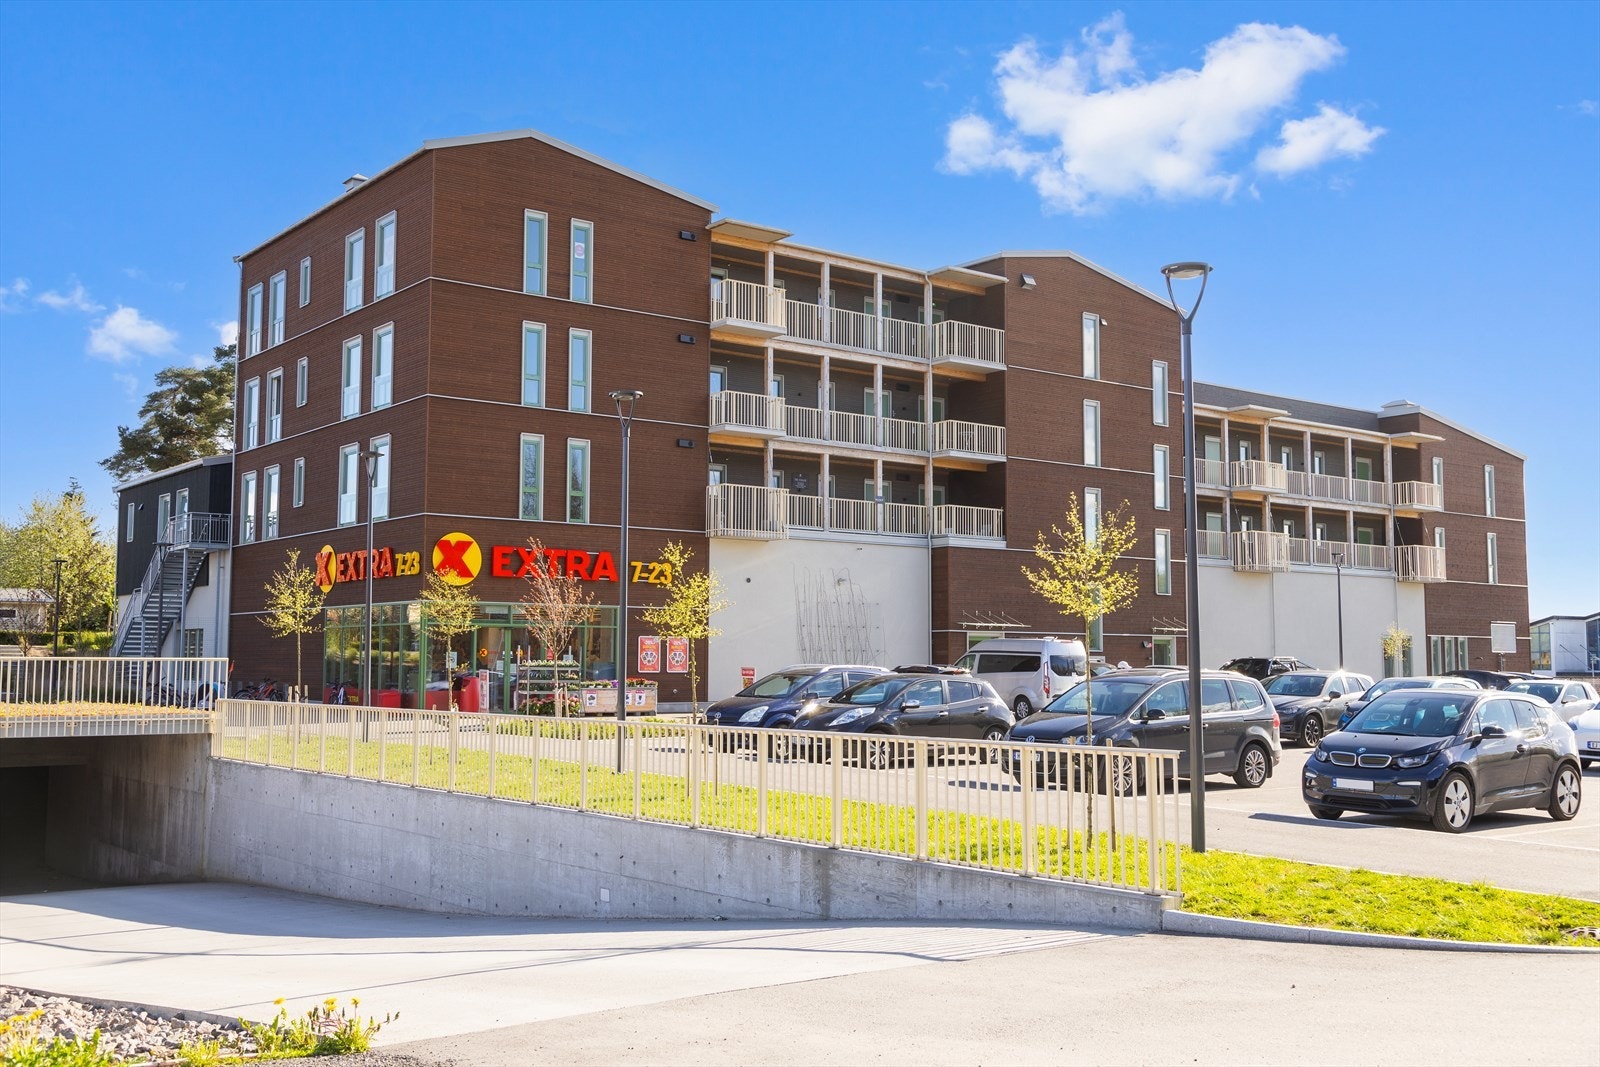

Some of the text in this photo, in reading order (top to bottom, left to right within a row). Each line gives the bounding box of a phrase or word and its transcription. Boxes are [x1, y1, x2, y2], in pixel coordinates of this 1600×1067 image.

[315, 547, 420, 587] X EXTRA 7-23
[435, 540, 673, 584] X EXTRA 7-23
